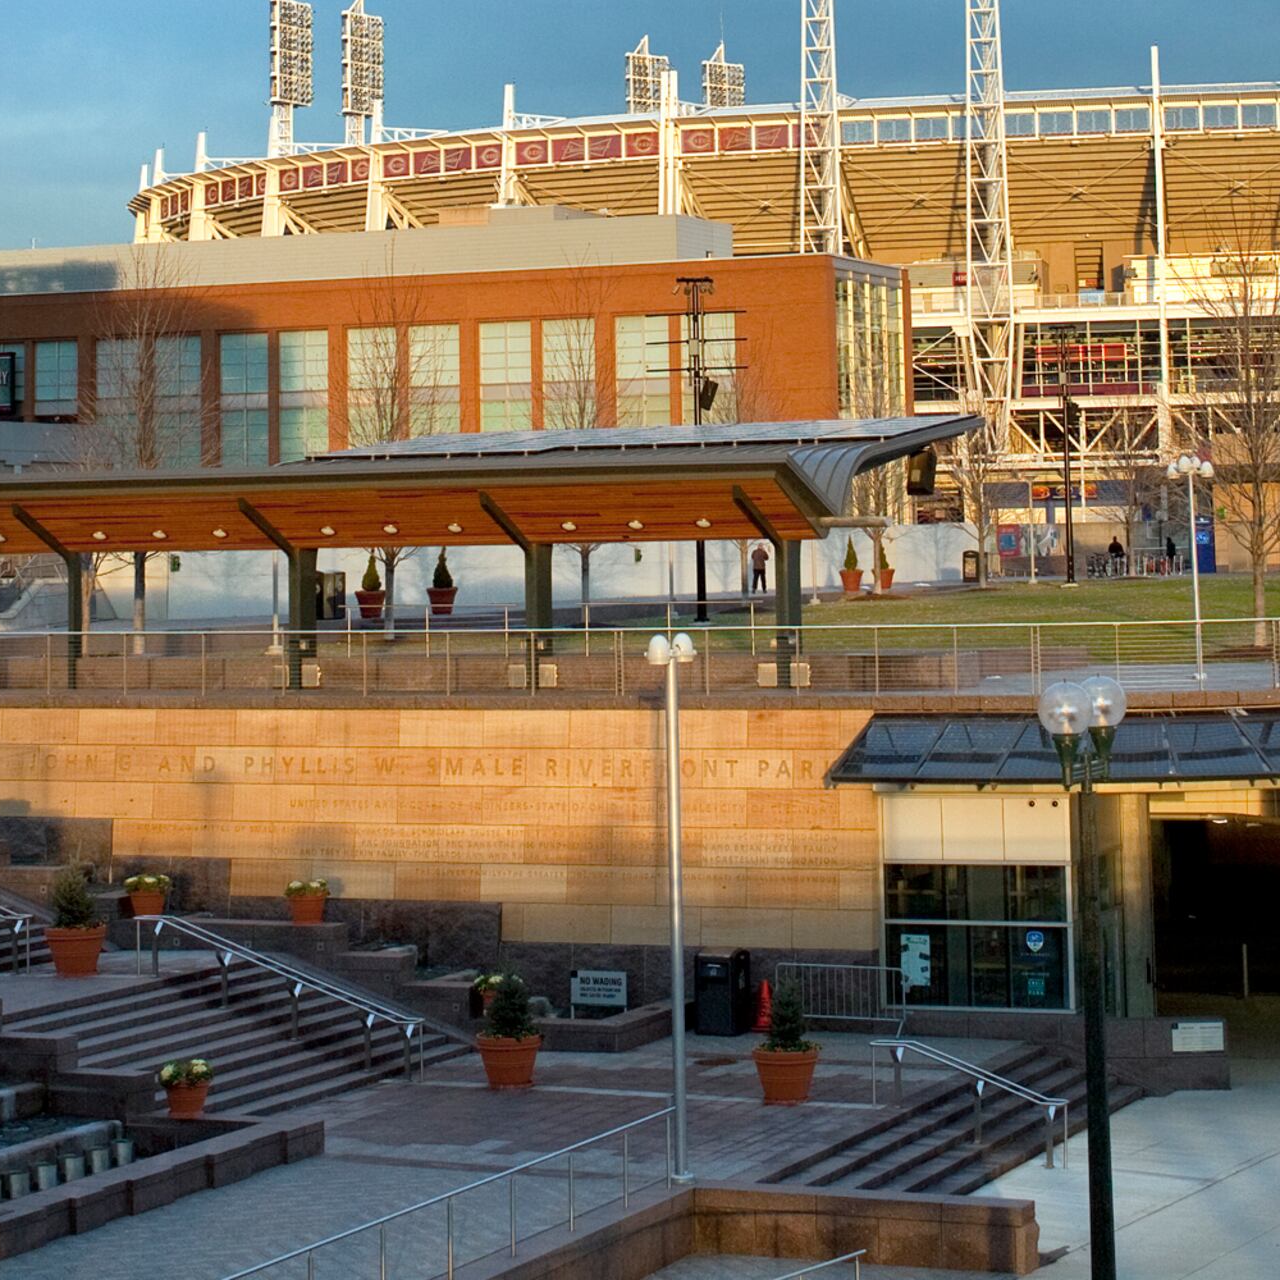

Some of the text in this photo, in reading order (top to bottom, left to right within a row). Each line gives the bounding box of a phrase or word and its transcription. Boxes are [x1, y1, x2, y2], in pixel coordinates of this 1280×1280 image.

[30, 752, 98, 771] JOHN
[158, 754, 216, 773] AND
[245, 756, 355, 775] PHYLLIS
[427, 758, 523, 777] SMALE
[545, 758, 738, 779] RIVERFONT
[580, 976, 622, 987] NO WADING
